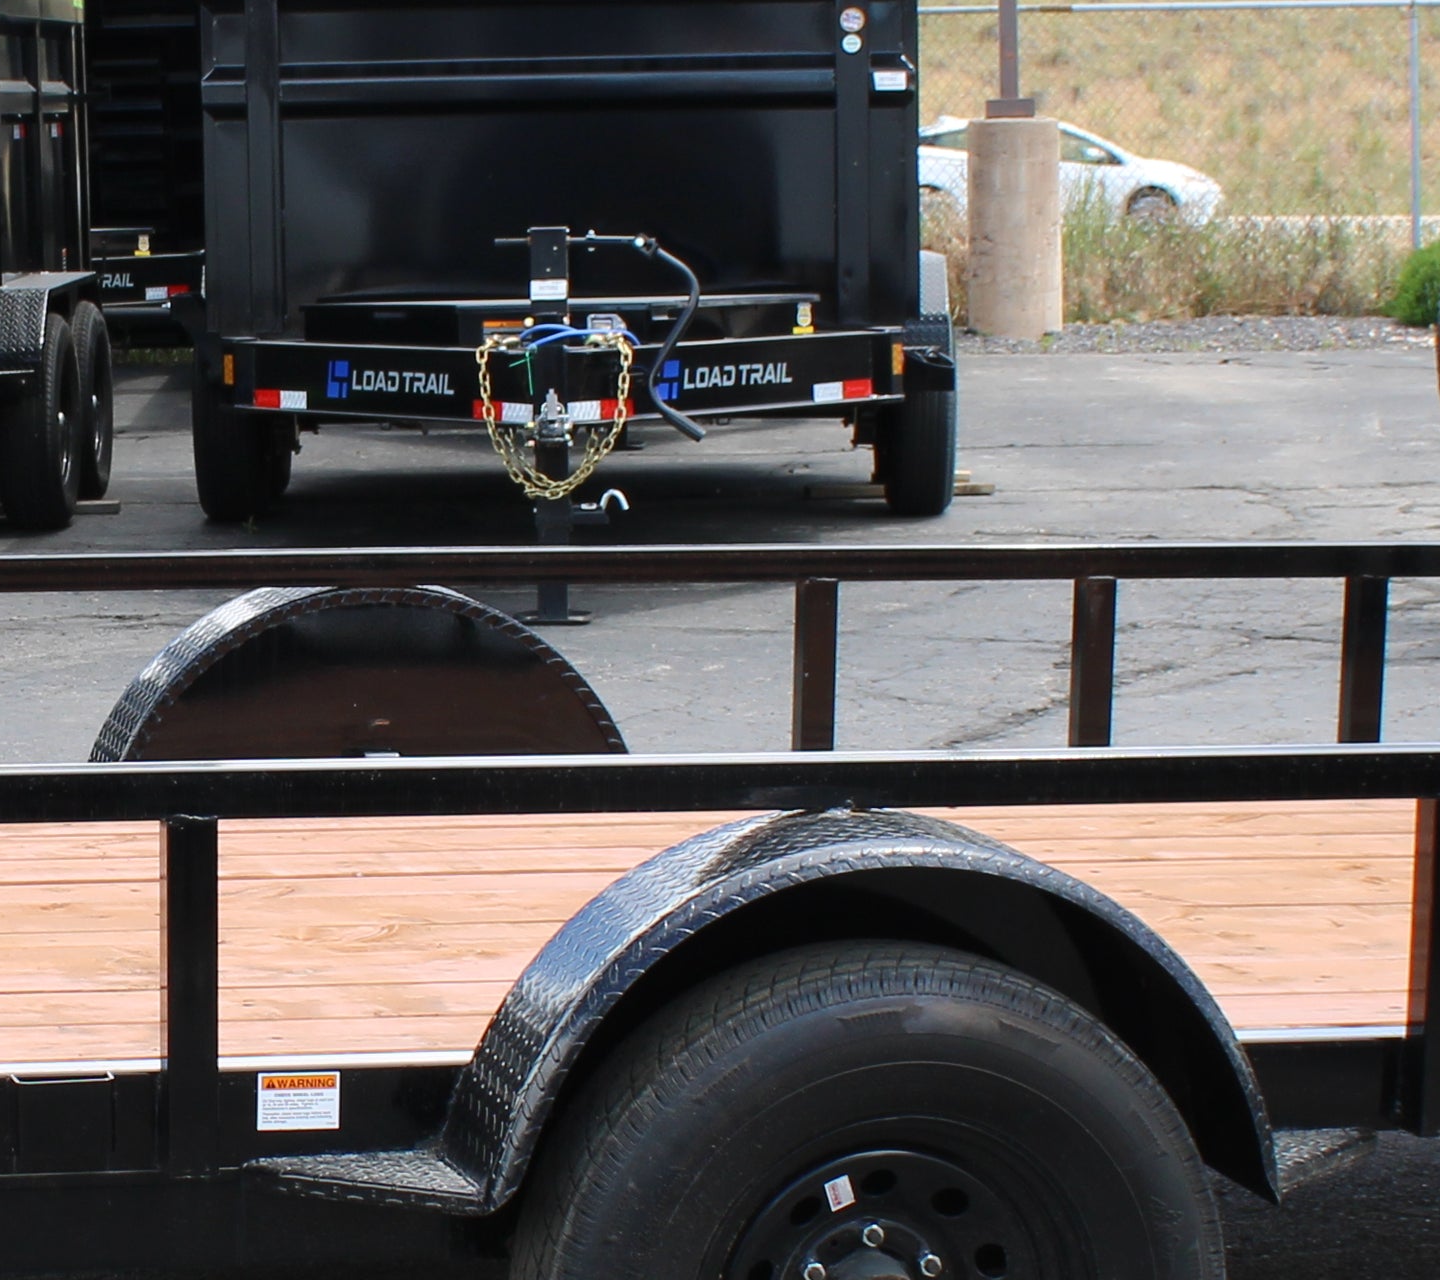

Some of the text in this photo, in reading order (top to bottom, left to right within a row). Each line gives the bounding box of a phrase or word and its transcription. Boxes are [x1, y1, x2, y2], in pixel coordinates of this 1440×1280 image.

[102, 273, 135, 288] RAIL
[351, 370, 455, 395] LOAD TRAIL
[683, 362, 793, 390] LOAD TRAIL
[277, 1078, 336, 1089] WARNING
